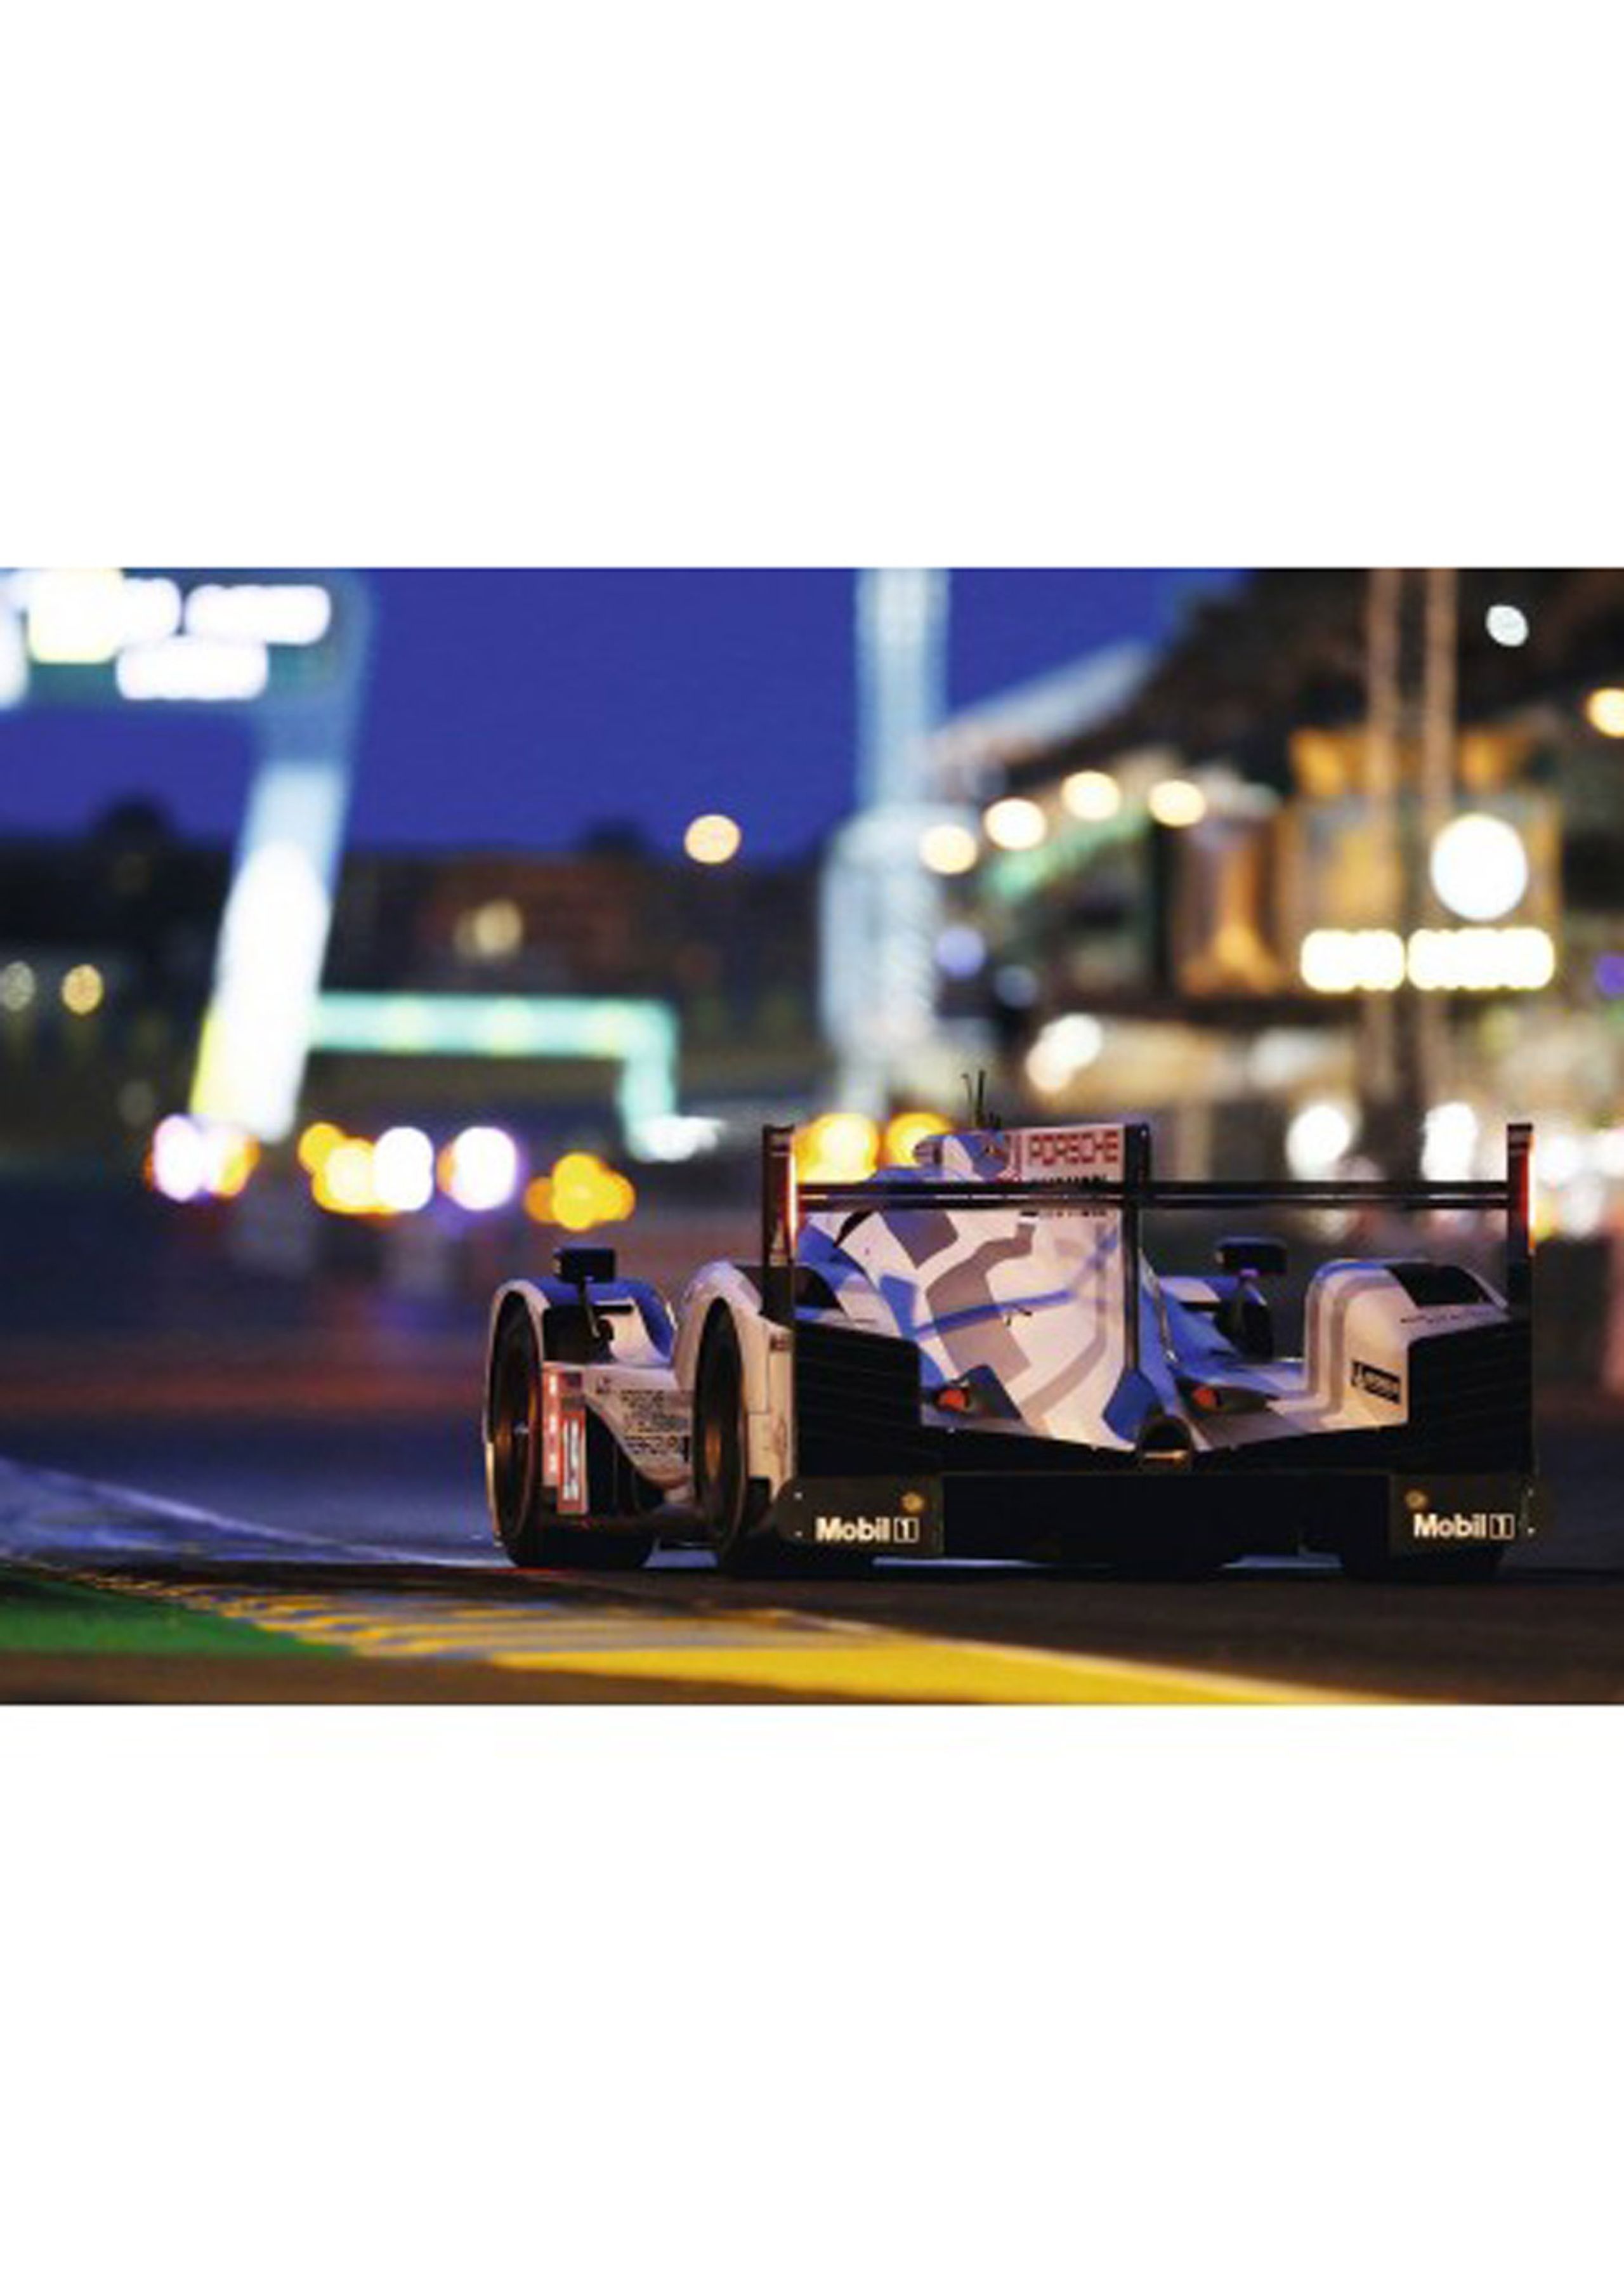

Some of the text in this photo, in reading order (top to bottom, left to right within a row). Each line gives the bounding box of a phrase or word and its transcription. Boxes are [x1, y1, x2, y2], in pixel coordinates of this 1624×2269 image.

[1030, 1129, 1118, 1165] PORSCHE
[815, 1516, 890, 1541] Mobil
[1413, 1513, 1486, 1538] Mobil
